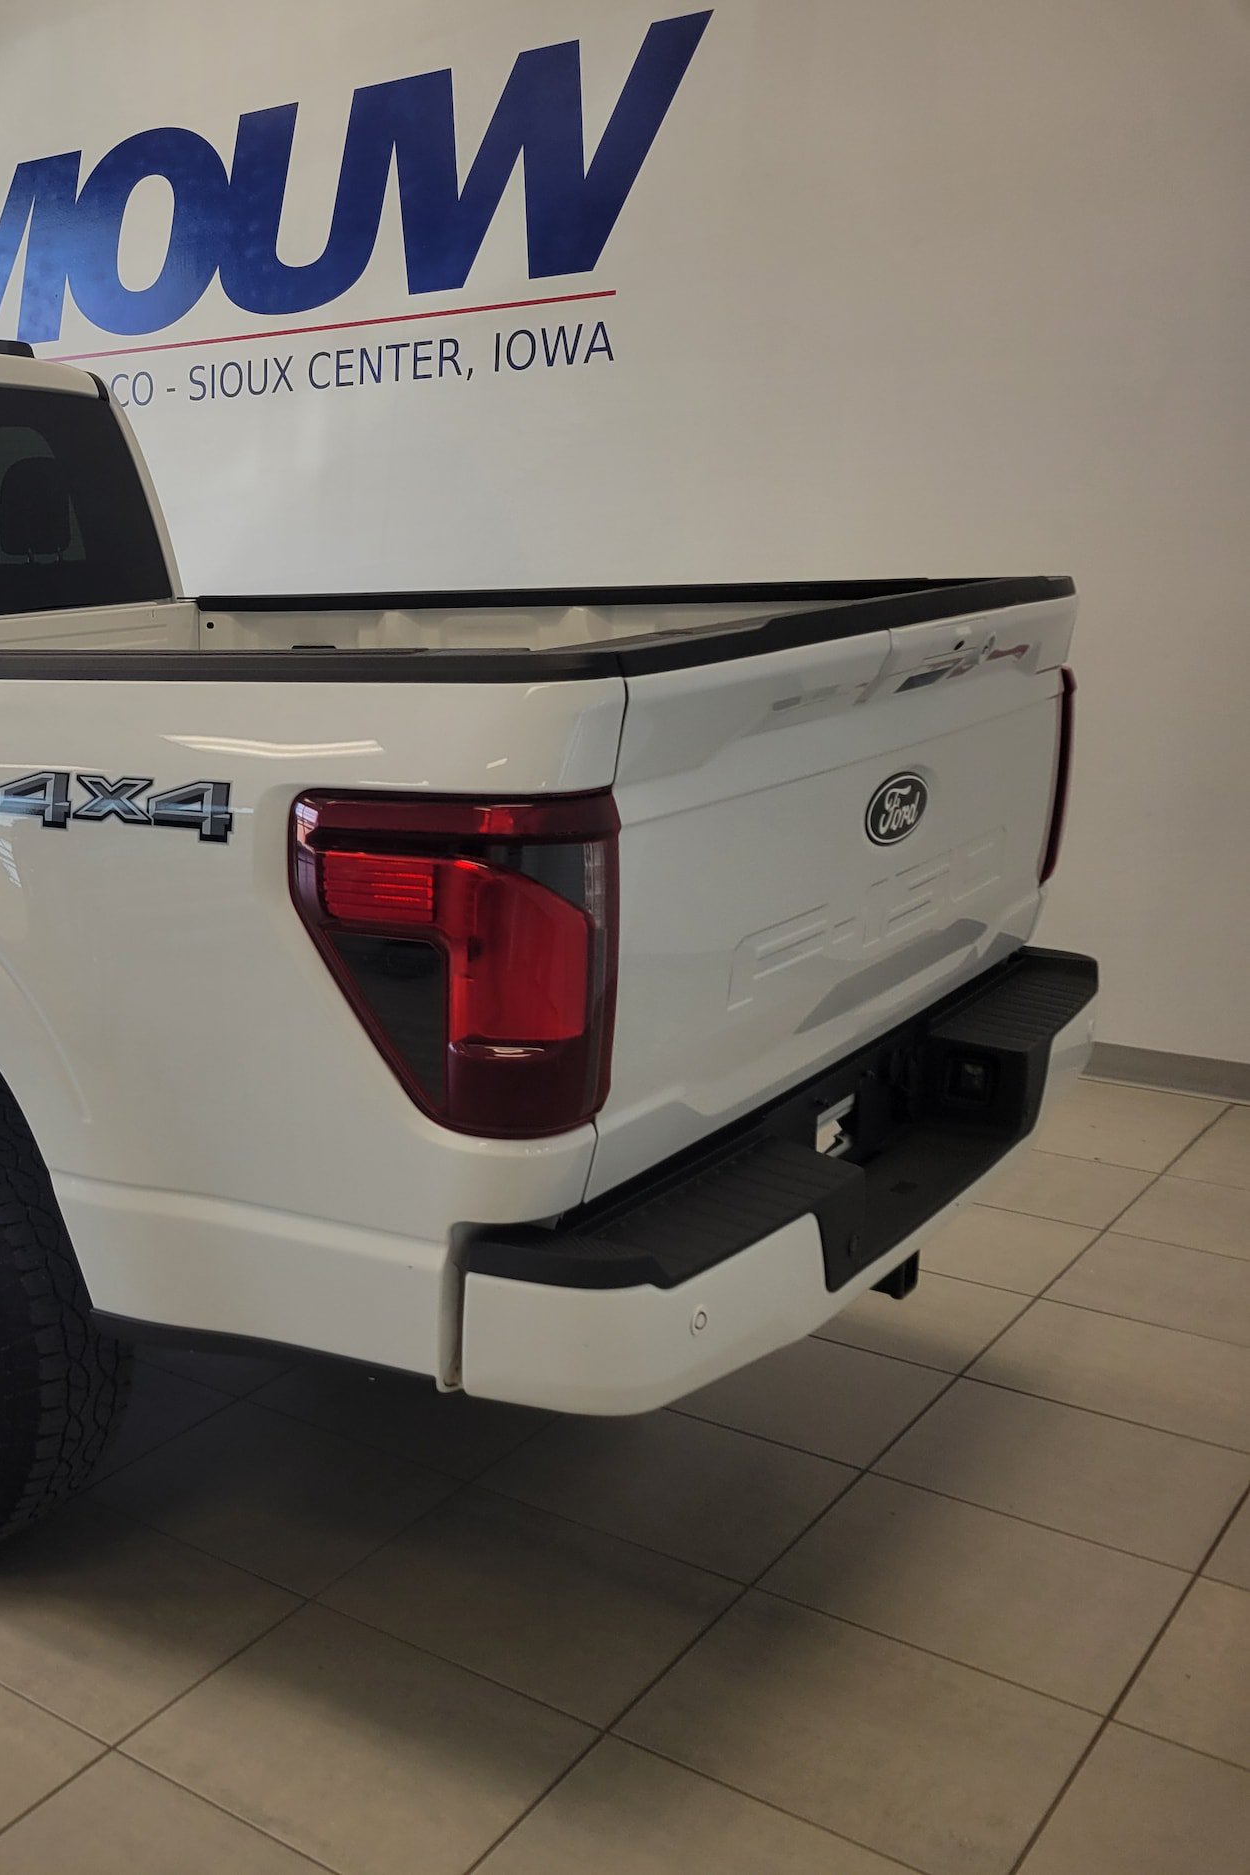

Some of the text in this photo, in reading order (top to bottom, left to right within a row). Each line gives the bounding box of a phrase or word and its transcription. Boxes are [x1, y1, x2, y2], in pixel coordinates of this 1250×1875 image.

[189, 355, 294, 401] SIOUX
[308, 337, 474, 390] CENTER,
[493, 321, 615, 373] IOWA
[879, 785, 920, 834] Ford
